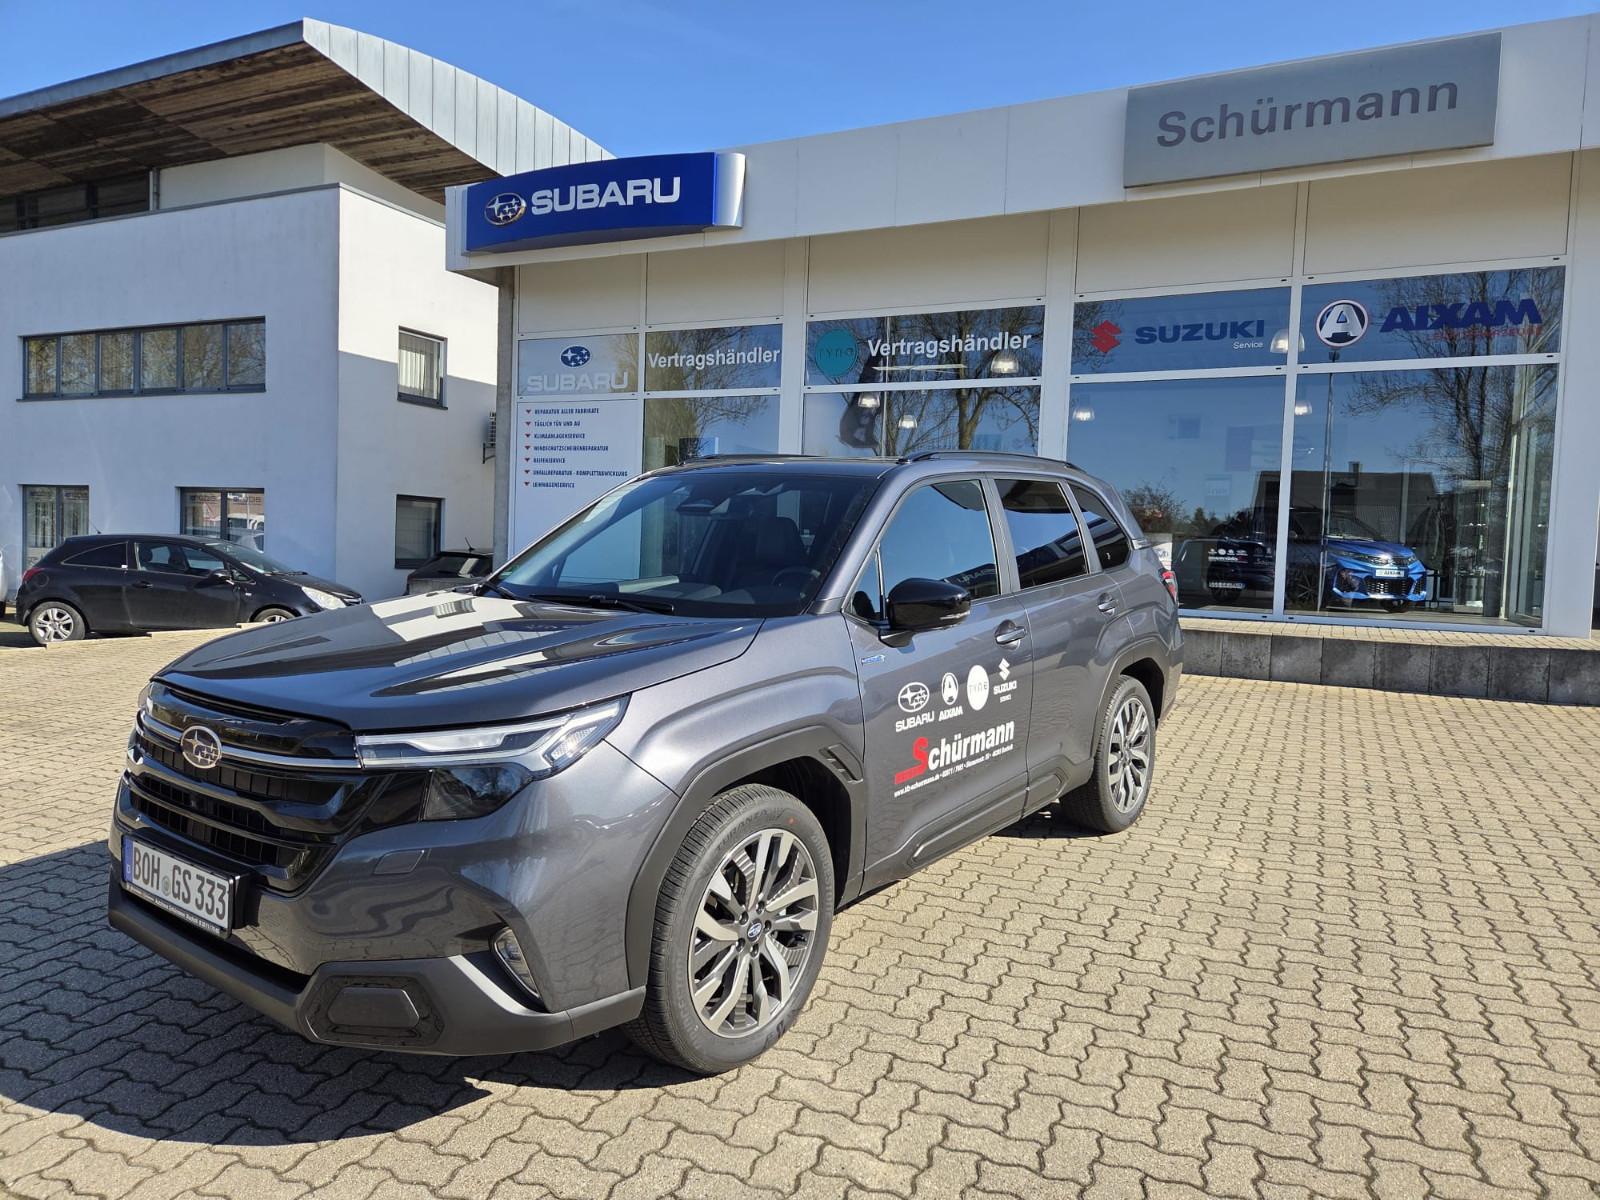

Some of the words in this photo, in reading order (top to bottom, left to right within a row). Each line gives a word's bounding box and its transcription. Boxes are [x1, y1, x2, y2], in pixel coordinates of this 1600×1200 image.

[1156, 82, 1459, 148] Schürmann
[531, 177, 681, 215] SUBARU
[1379, 299, 1543, 332] AIXAM
[1135, 319, 1265, 344] SUZUKI
[868, 332, 1032, 358] Vertragshändler
[1232, 341, 1264, 350] Service
[647, 347, 781, 370] Vertragshändler
[527, 371, 629, 392] SUBARU
[895, 711, 935, 733] SUBARU
[894, 720, 1015, 785] Schürmann
[133, 846, 161, 890] BOH
[172, 864, 192, 905] GS
[195, 874, 227, 921] 333
